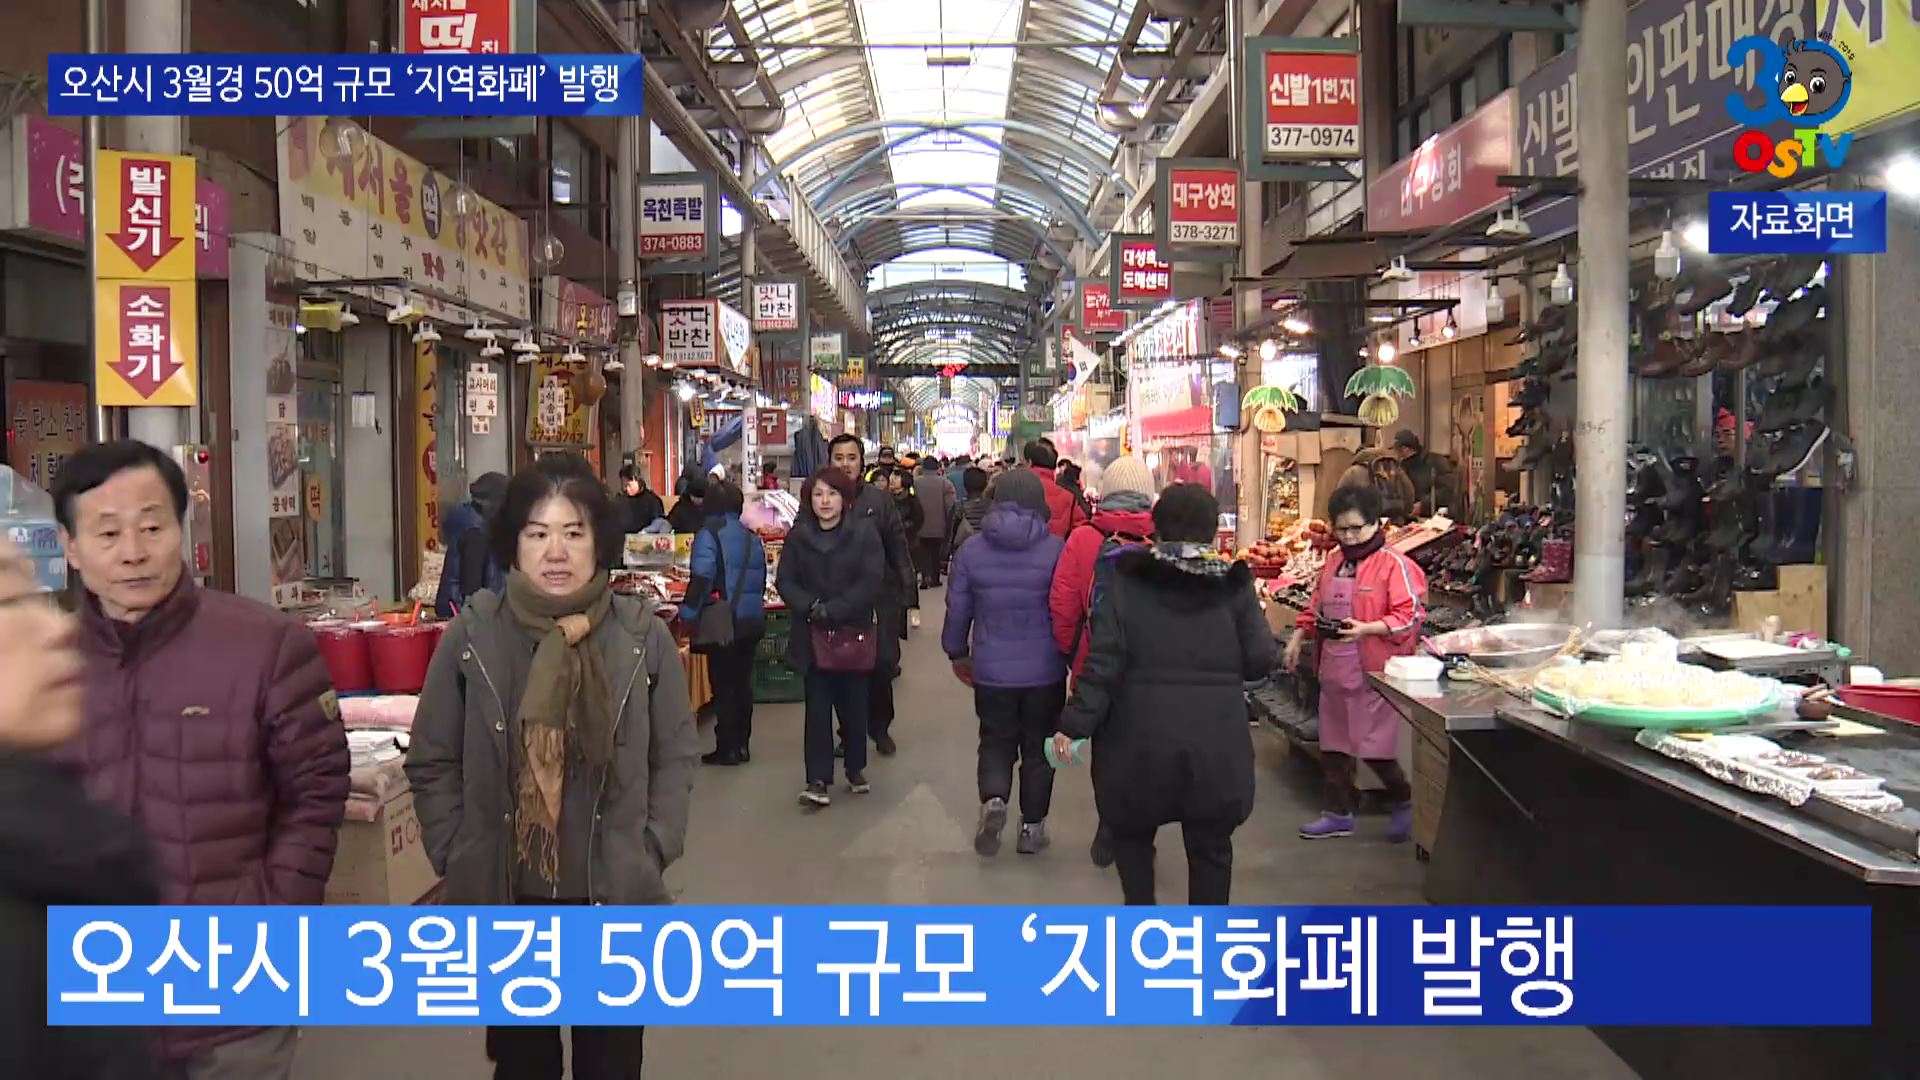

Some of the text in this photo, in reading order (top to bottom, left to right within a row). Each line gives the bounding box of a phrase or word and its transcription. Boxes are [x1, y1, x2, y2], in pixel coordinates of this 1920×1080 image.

[1269, 73, 1355, 106] 신발1번지
[1271, 128, 1354, 147] 377-0974
[1172, 182, 1236, 209] 대구상회
[128, 166, 166, 257] 발신기
[643, 197, 703, 222] 옥천족발
[1173, 225, 1235, 241] 378-3271
[643, 236, 702, 251] 374-0883
[1122, 271, 1169, 290] 도매센터
[759, 284, 793, 302] 맛나
[759, 303, 793, 318] 반찬
[127, 295, 165, 383] 소화기
[668, 328, 711, 348] 반찬
